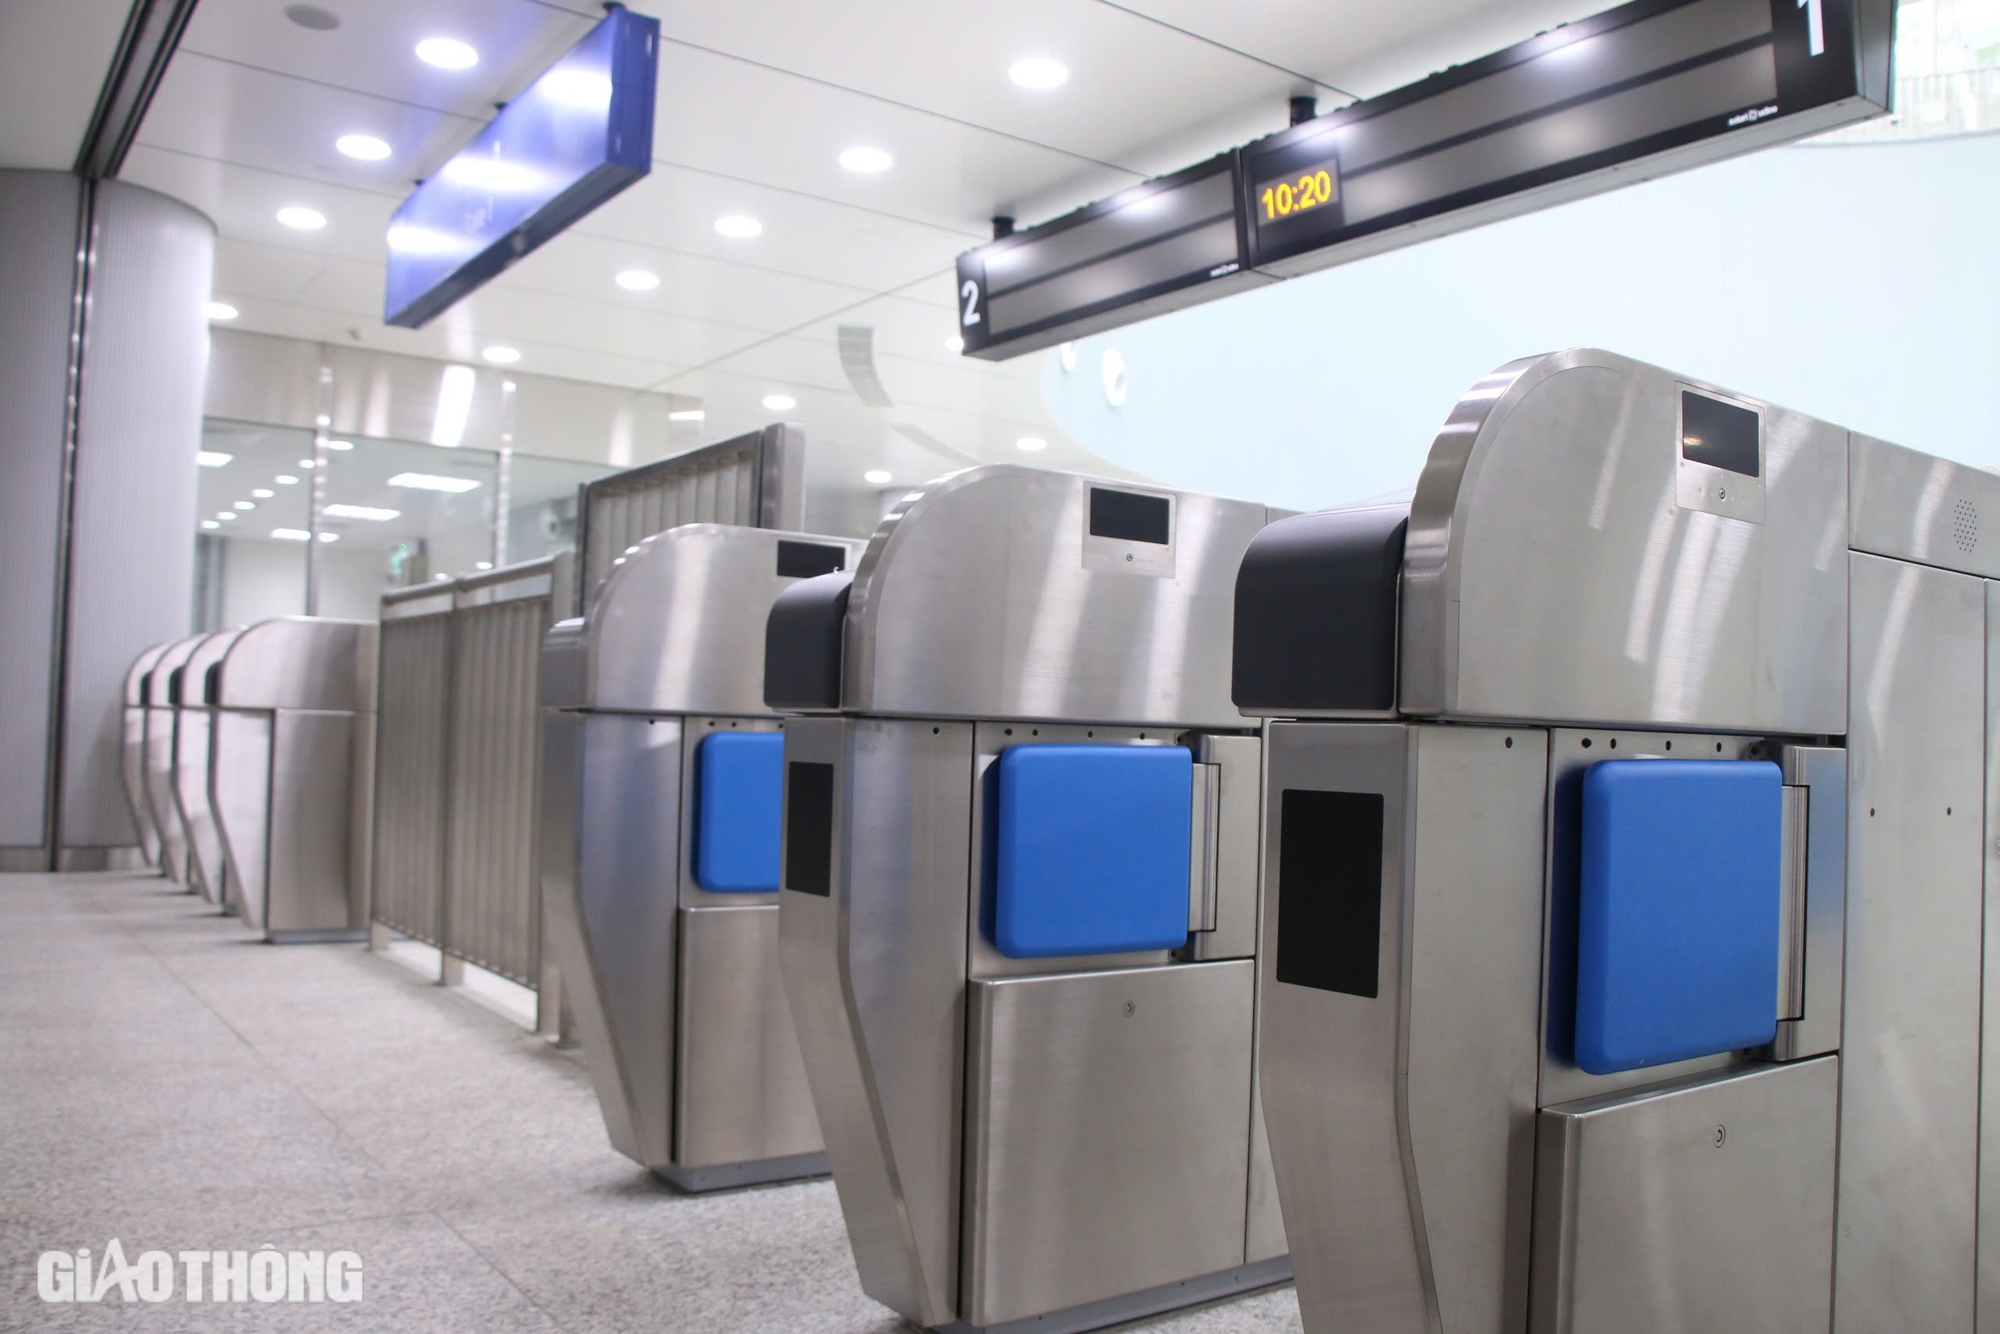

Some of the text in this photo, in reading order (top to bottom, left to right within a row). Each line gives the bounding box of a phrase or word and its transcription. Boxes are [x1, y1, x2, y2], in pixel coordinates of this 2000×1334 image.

[1797, 0, 1824, 57] 1
[1262, 170, 1331, 219] 10:20
[961, 279, 981, 327] 2
